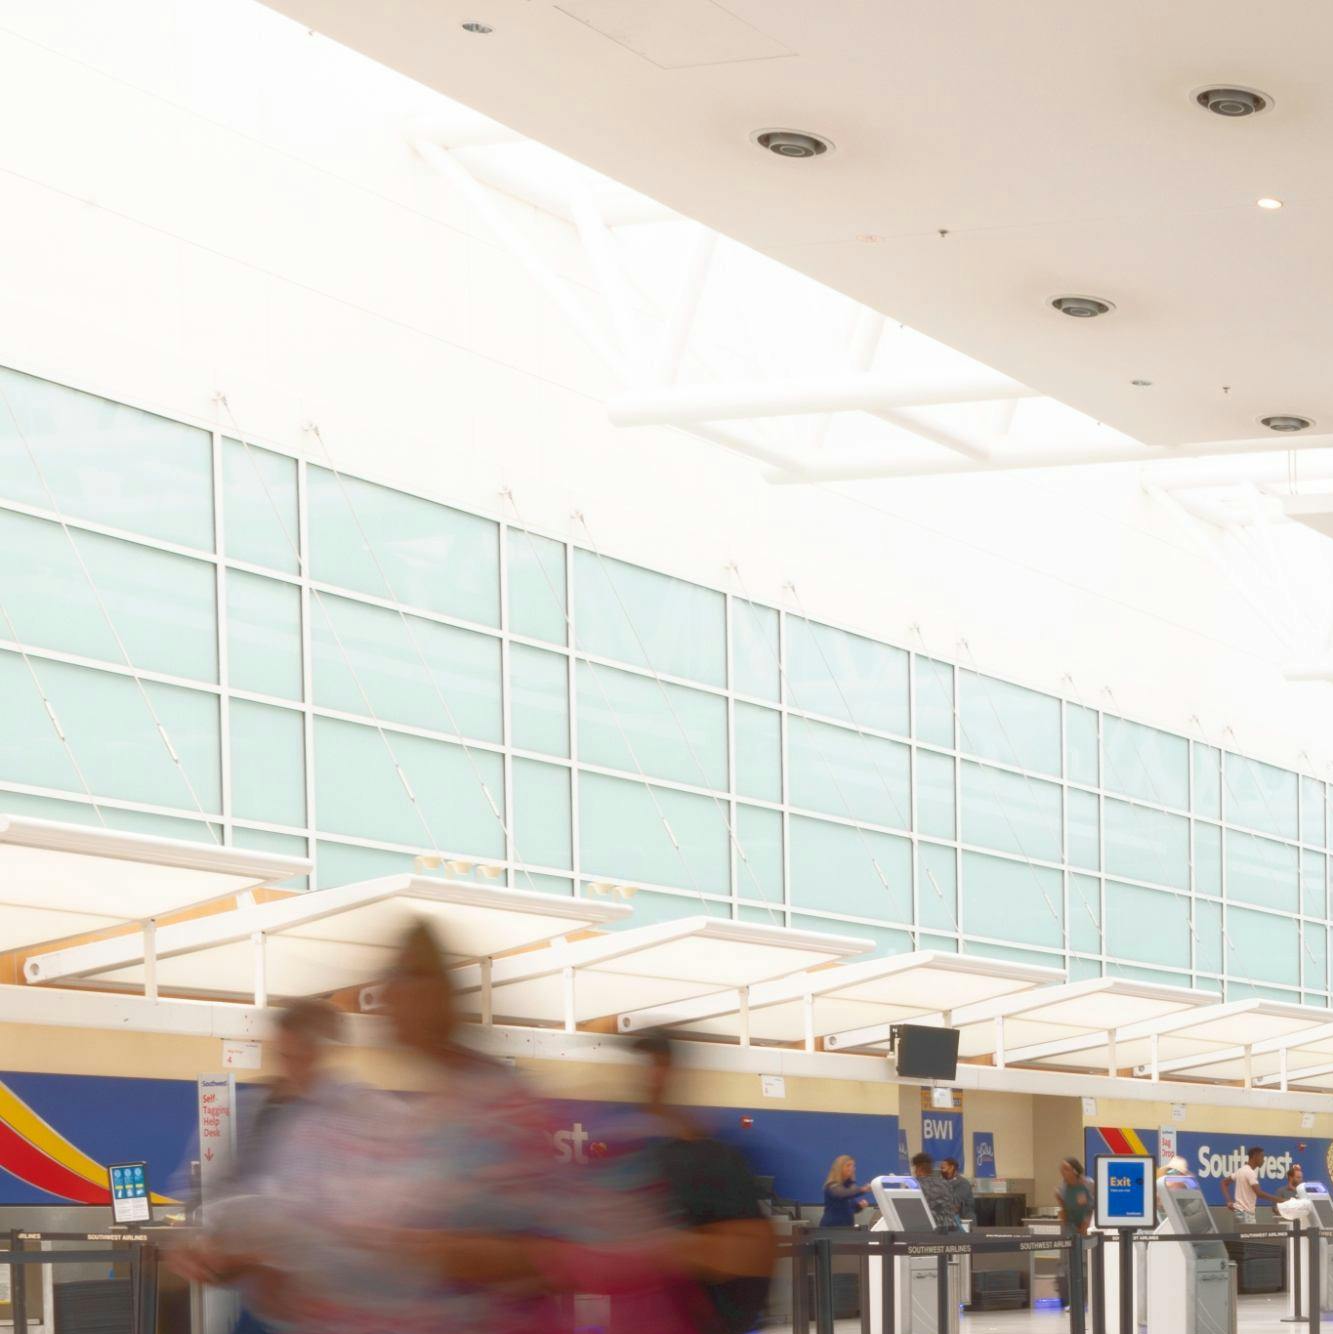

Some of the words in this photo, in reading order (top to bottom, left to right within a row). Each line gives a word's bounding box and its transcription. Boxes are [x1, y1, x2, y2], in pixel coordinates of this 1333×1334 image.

[203, 1106, 230, 1116] Tagging
[204, 1117, 219, 1127] Help
[204, 1129, 220, 1137] Desk
[923, 1119, 953, 1140] BWI
[1110, 1177, 1131, 1187] Exit
[908, 1246, 943, 1254] SOUTHWEST
[945, 1245, 971, 1253] AIRLINES
[1020, 1241, 1052, 1250] SOUTHWEST
